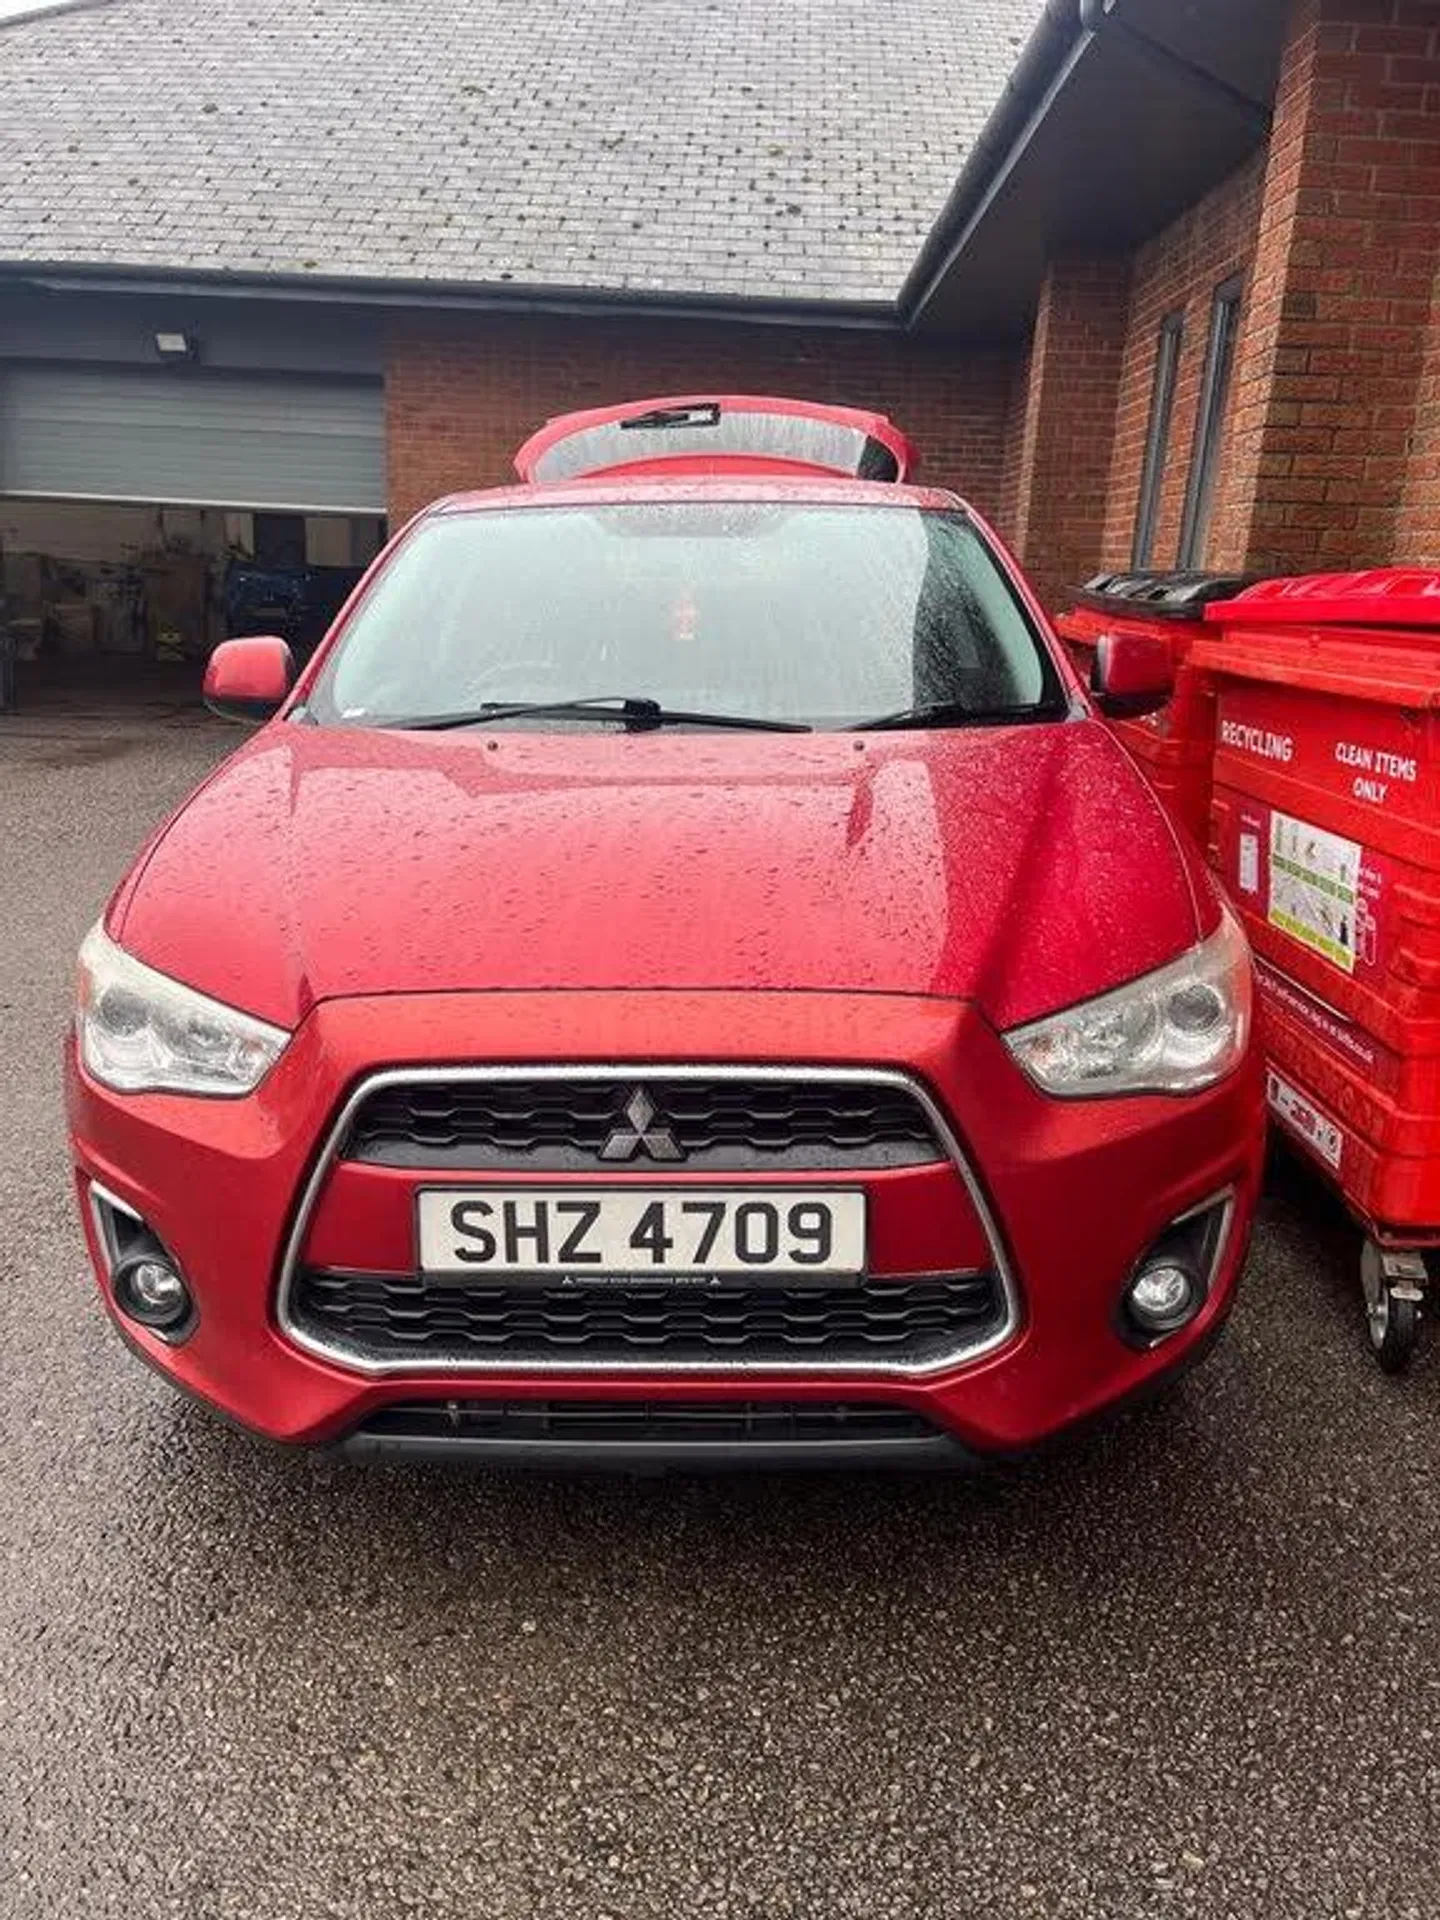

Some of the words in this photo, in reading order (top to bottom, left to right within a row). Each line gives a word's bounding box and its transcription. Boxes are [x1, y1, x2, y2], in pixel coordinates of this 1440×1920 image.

[1222, 720, 1293, 761] RECYCLING
[1335, 742, 1370, 769] CLEAN
[1375, 748, 1417, 781] ITEMS
[1353, 778, 1387, 803] ONLY
[450, 1200, 602, 1264] SHZ
[629, 1201, 832, 1264] 4709
